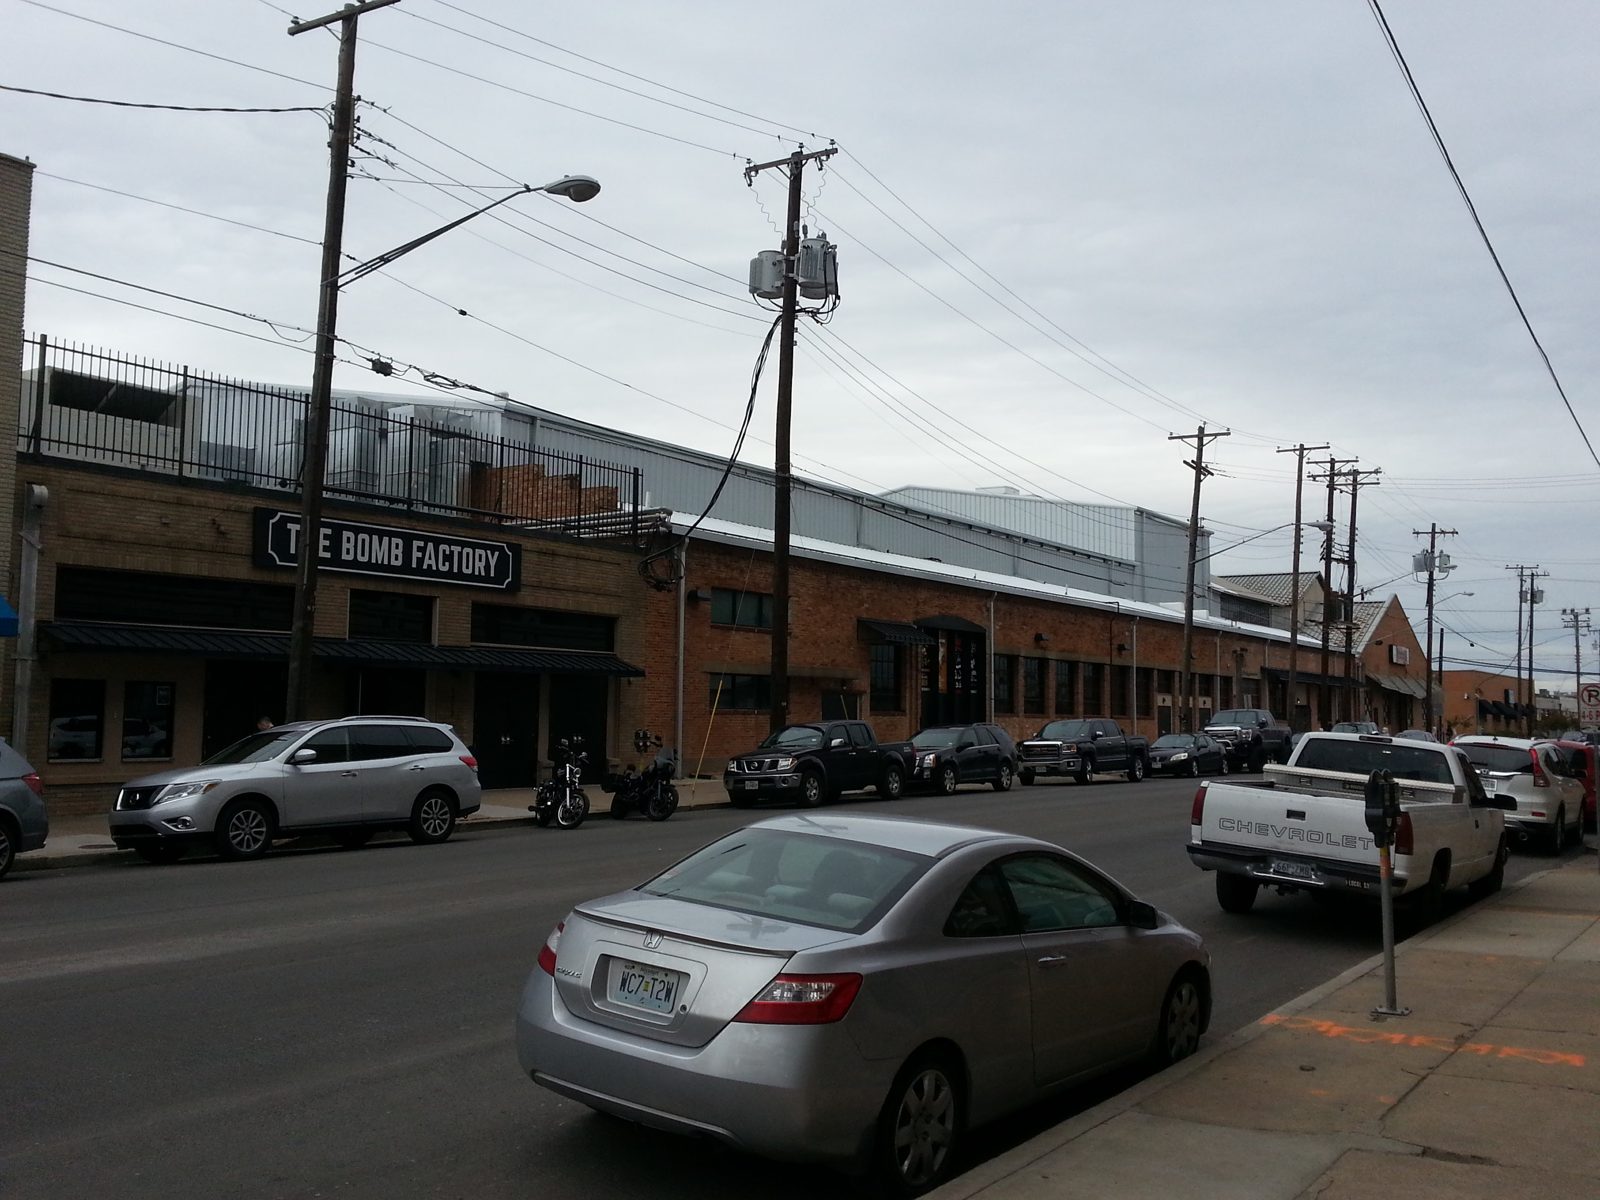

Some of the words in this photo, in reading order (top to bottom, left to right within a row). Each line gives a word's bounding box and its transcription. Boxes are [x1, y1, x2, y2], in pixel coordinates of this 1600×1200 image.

[286, 522, 332, 559] TE
[341, 530, 403, 567] BOMB
[411, 540, 500, 577] FACTORY
[1218, 817, 1374, 850] CHEVROLET
